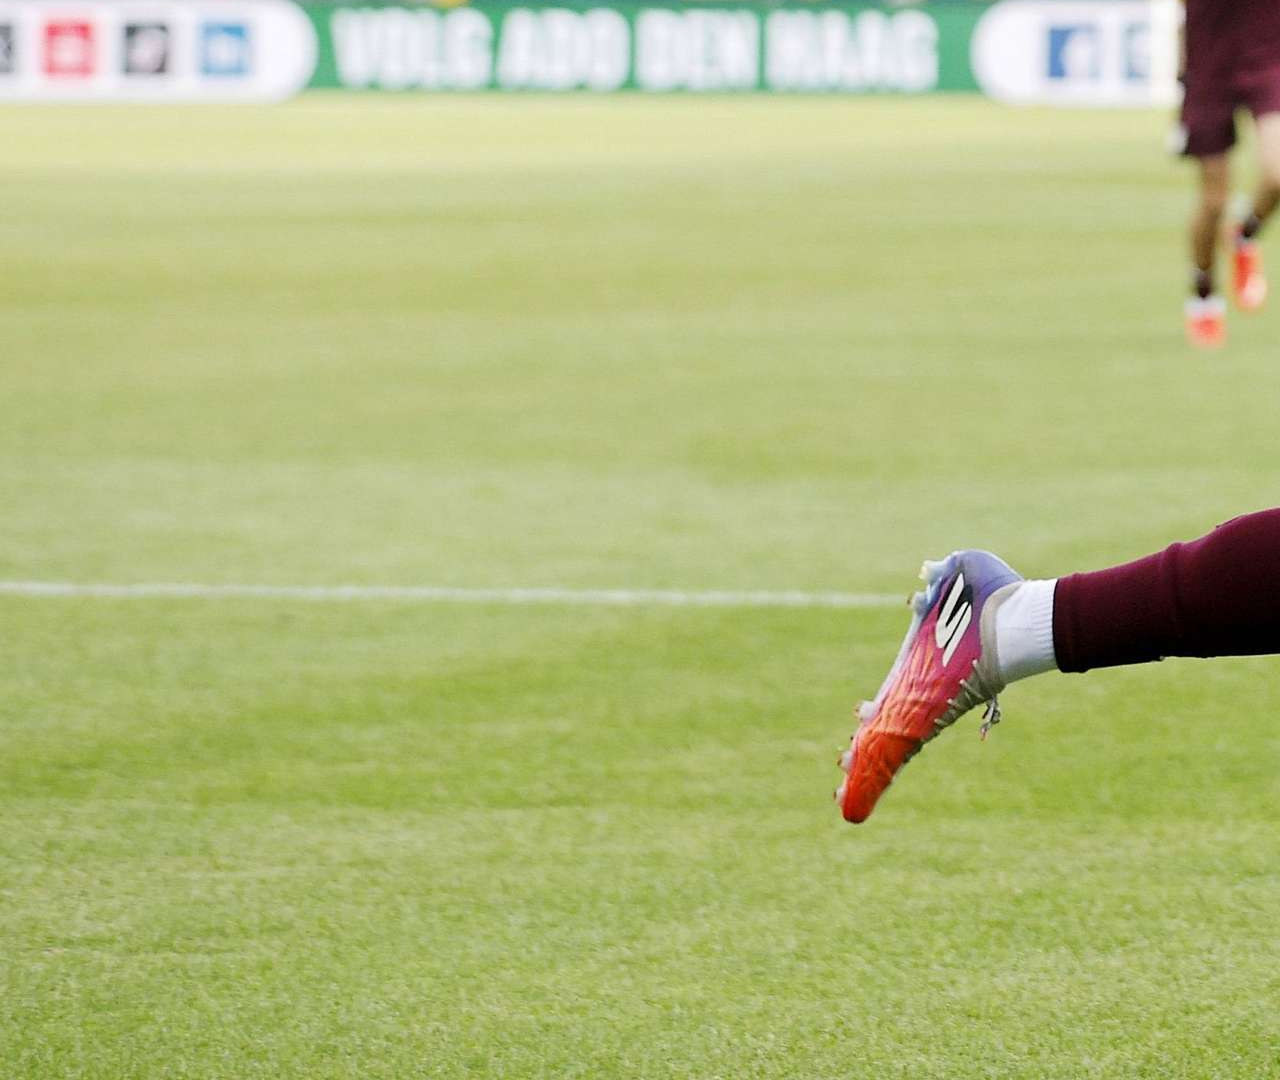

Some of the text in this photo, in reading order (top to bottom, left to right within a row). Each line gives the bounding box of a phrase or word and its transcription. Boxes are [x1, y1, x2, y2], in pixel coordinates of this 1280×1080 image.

[331, 8, 939, 90] VOLG ADO DEN HAAG
